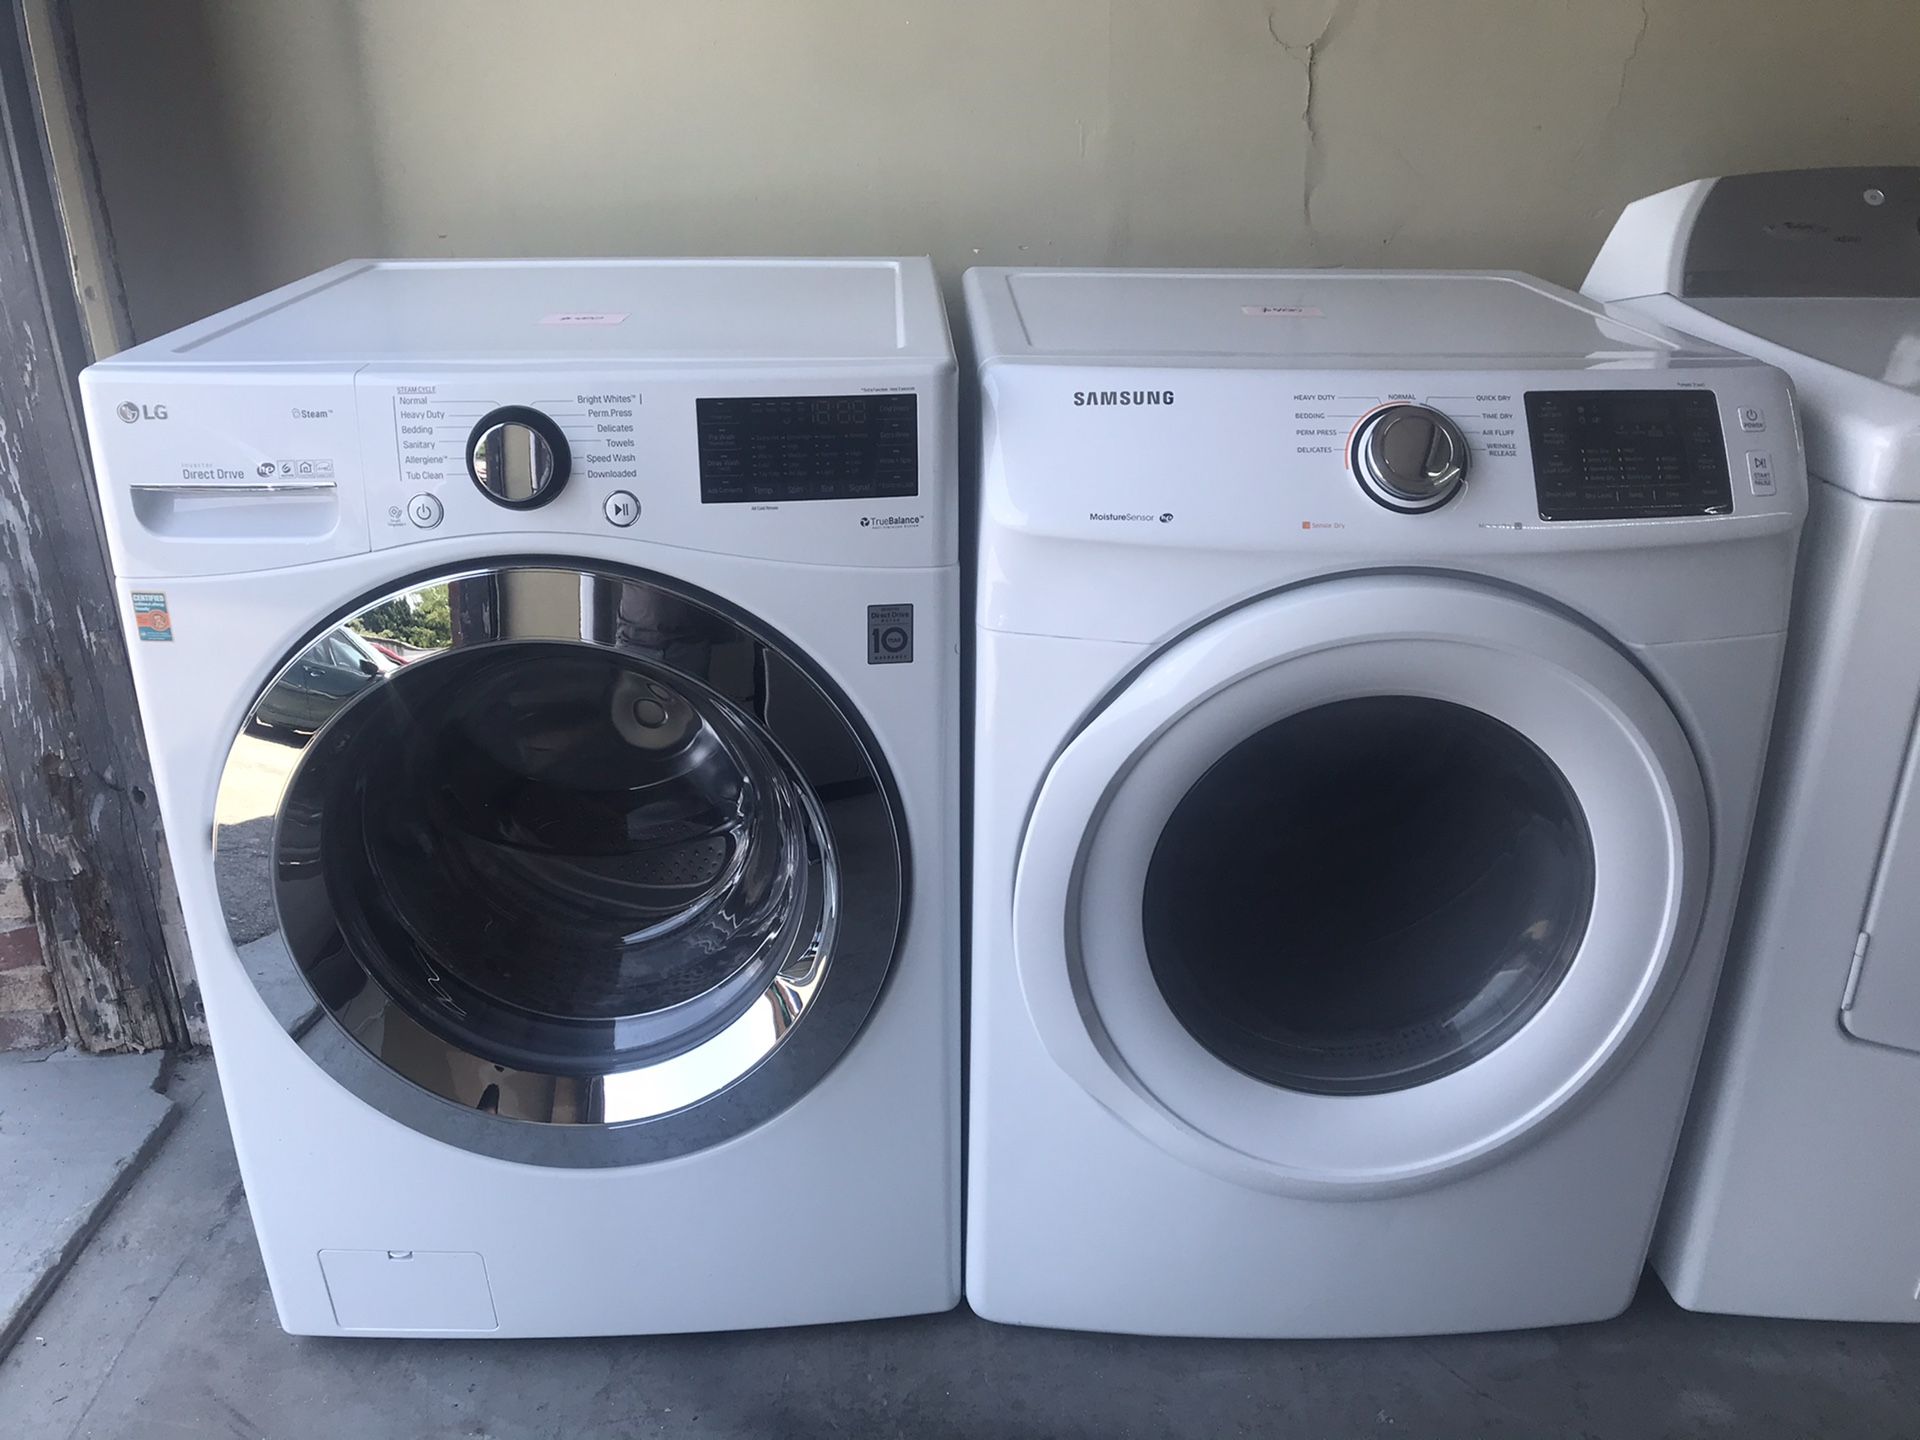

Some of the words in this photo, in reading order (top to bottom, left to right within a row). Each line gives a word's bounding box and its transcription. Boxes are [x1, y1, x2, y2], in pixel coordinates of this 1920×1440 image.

[399, 396, 428, 405] Normal
[577, 394, 602, 405] Bright
[1073, 390, 1175, 406] SAMSUNG
[142, 404, 169, 420] LG
[400, 411, 425, 420] Heavy
[426, 410, 445, 419] Duty
[610, 408, 633, 417] Press
[401, 425, 433, 435] Bedding
[597, 424, 634, 432] Delicates
[403, 440, 435, 449] Sanitary
[606, 438, 635, 447] Towels
[586, 454, 611, 463] Speed
[612, 453, 636, 462] Wash
[183, 469, 215, 480] Direct
[217, 468, 244, 480] Drive
[406, 471, 421, 480] Tub
[422, 471, 444, 480] Clean
[587, 470, 637, 479] Downloaded
[872, 626, 908, 654] 10
